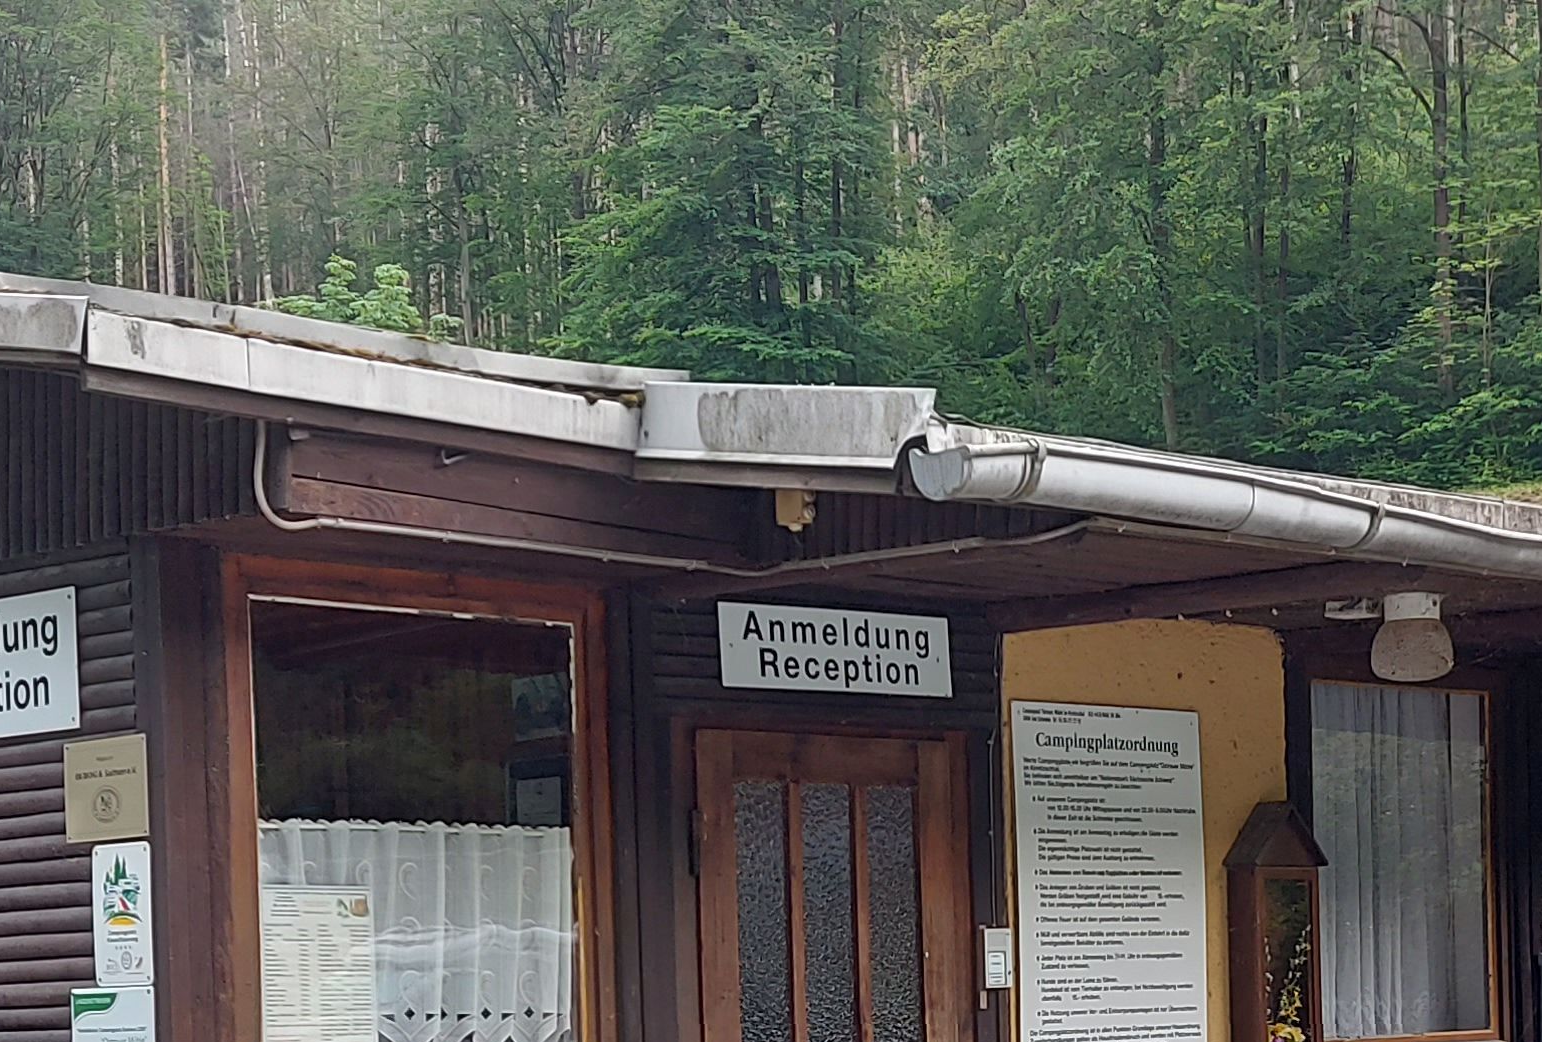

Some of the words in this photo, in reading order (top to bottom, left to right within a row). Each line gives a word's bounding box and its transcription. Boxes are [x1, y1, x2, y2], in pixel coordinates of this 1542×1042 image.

[742, 609, 930, 659] Anmeldung
[758, 646, 920, 689] Reception
[1035, 731, 1180, 757] Campingplatzordnung
